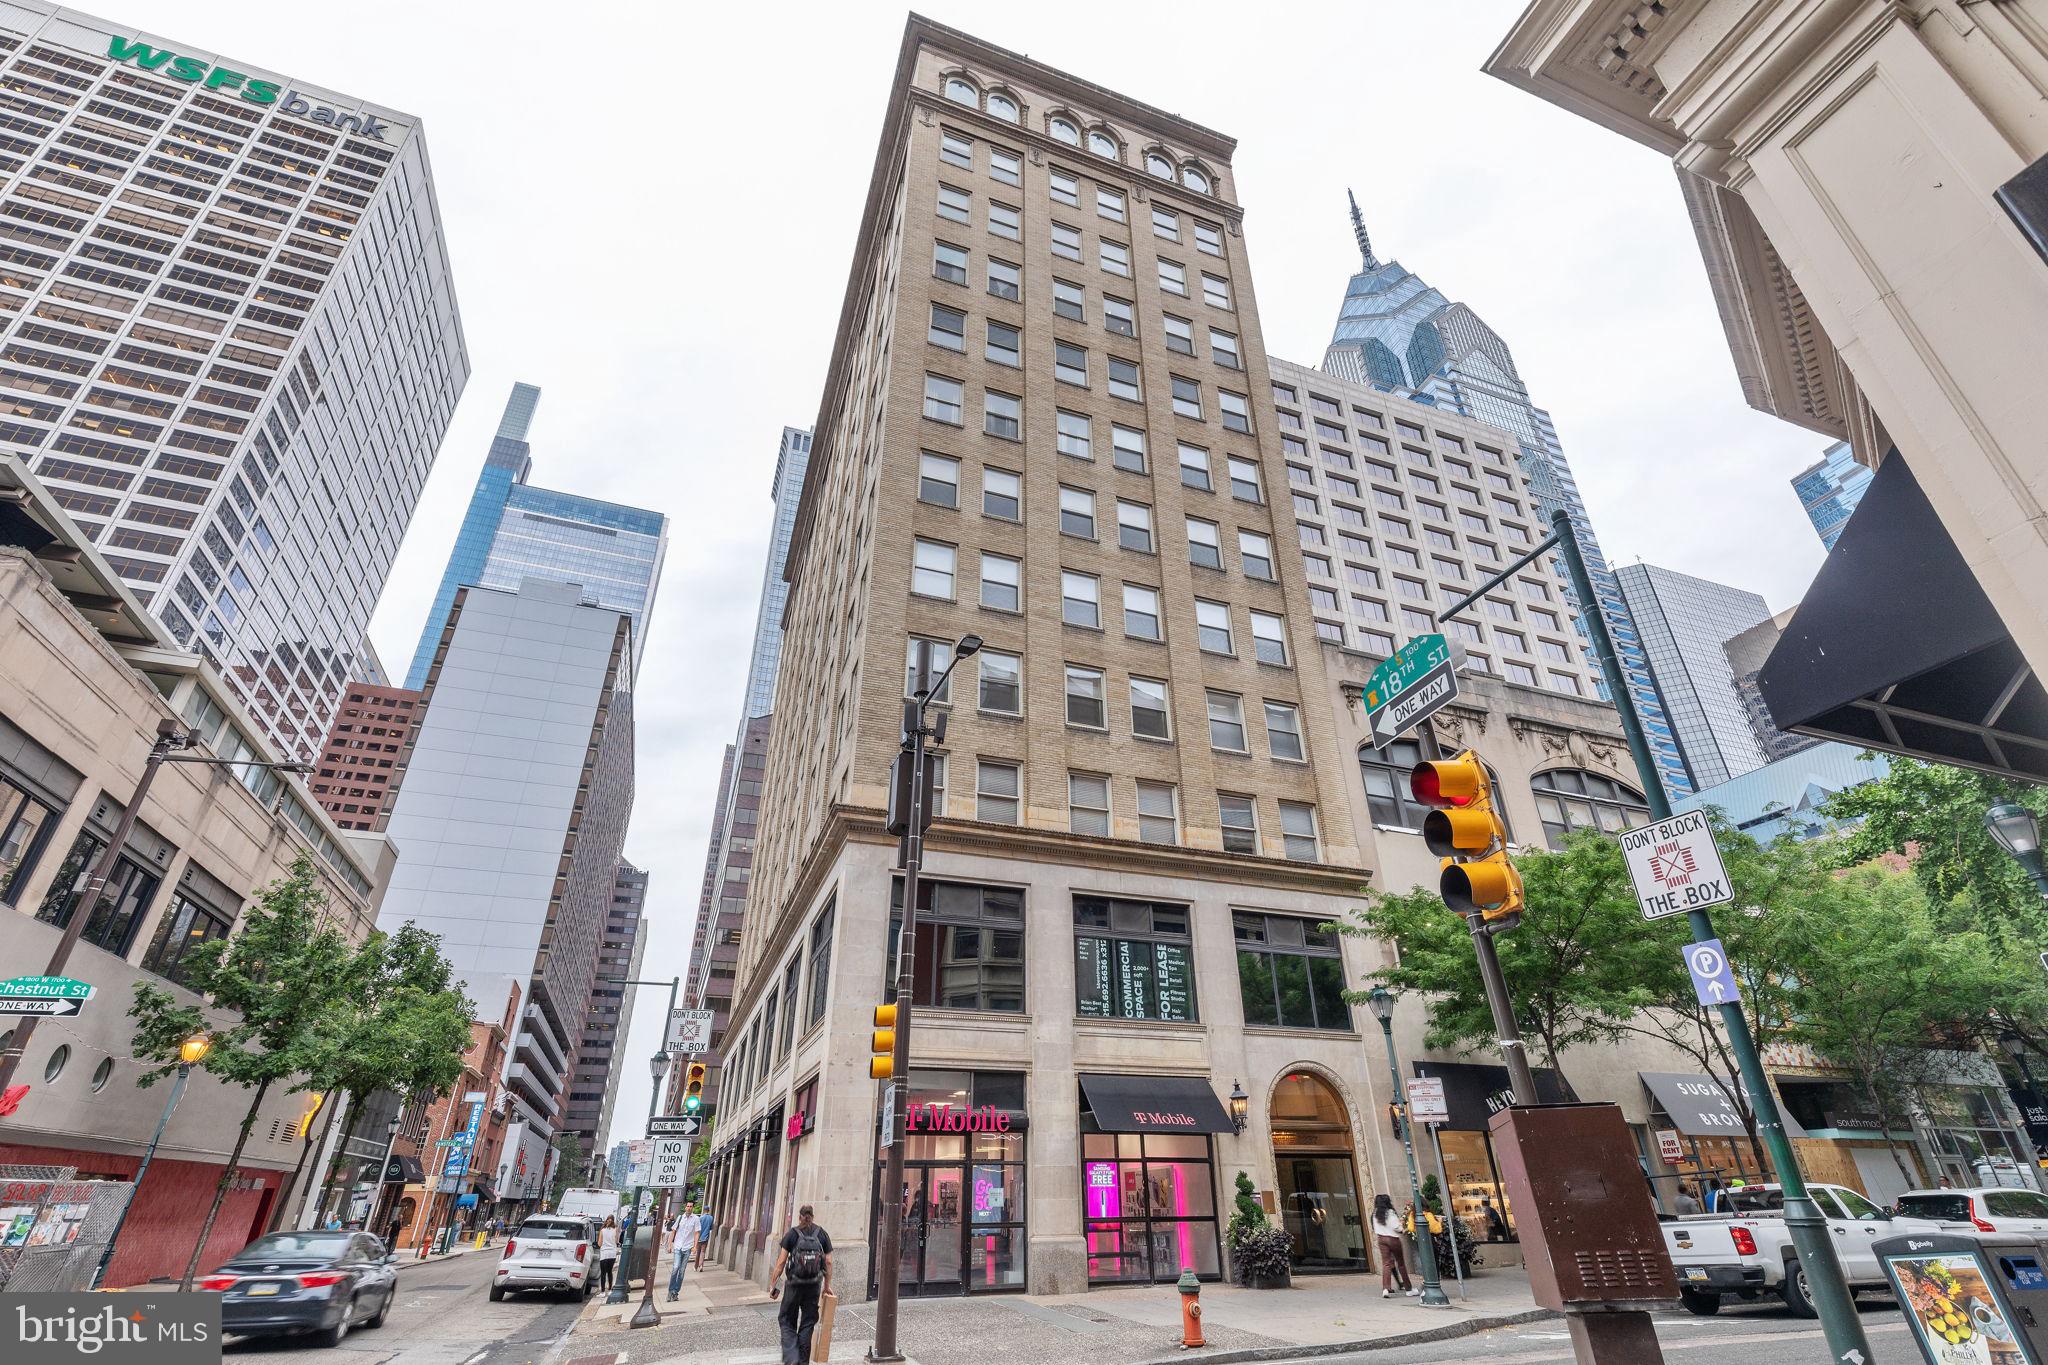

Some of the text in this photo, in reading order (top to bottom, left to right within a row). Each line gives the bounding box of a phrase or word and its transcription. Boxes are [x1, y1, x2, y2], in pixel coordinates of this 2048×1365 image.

[107, 34, 388, 141] WSFS bank
[1405, 642, 1419, 657] 100
[1380, 644, 1445, 700] 18TH ST
[1394, 677, 1444, 722] ONE WAY
[1624, 814, 1704, 852] DON'T BLOCK
[1645, 879, 1726, 915] THE BOX
[1156, 944, 1172, 1020] FOR LEASE
[71, 985, 87, 996] St
[1133, 980, 1145, 1019] SPACE
[26, 1002, 54, 1010] WAY
[691, 1011, 712, 1020] BLOCK
[669, 1042, 706, 1052] THE BOX
[1485, 1089, 1517, 1113] HEYD
[2025, 1106, 2045, 1116] just
[927, 1103, 1010, 1132] Mobile
[1147, 1112, 1197, 1126] Mobile
[1698, 1112, 1744, 1126] BRON
[1836, 1118, 1862, 1128] south
[1862, 1120, 1882, 1128] moo
[653, 1122, 685, 1130] ONE WAY
[663, 1142, 681, 1154] NO
[1662, 1139, 1677, 1147] FOR
[1662, 1147, 1680, 1155] RENT
[658, 1155, 683, 1164] TURN
[663, 1165, 676, 1173] ON
[658, 1174, 677, 1183] RED
[1092, 1175, 1112, 1185] FREE
[1907, 1240, 1934, 1250] Bigbelly
